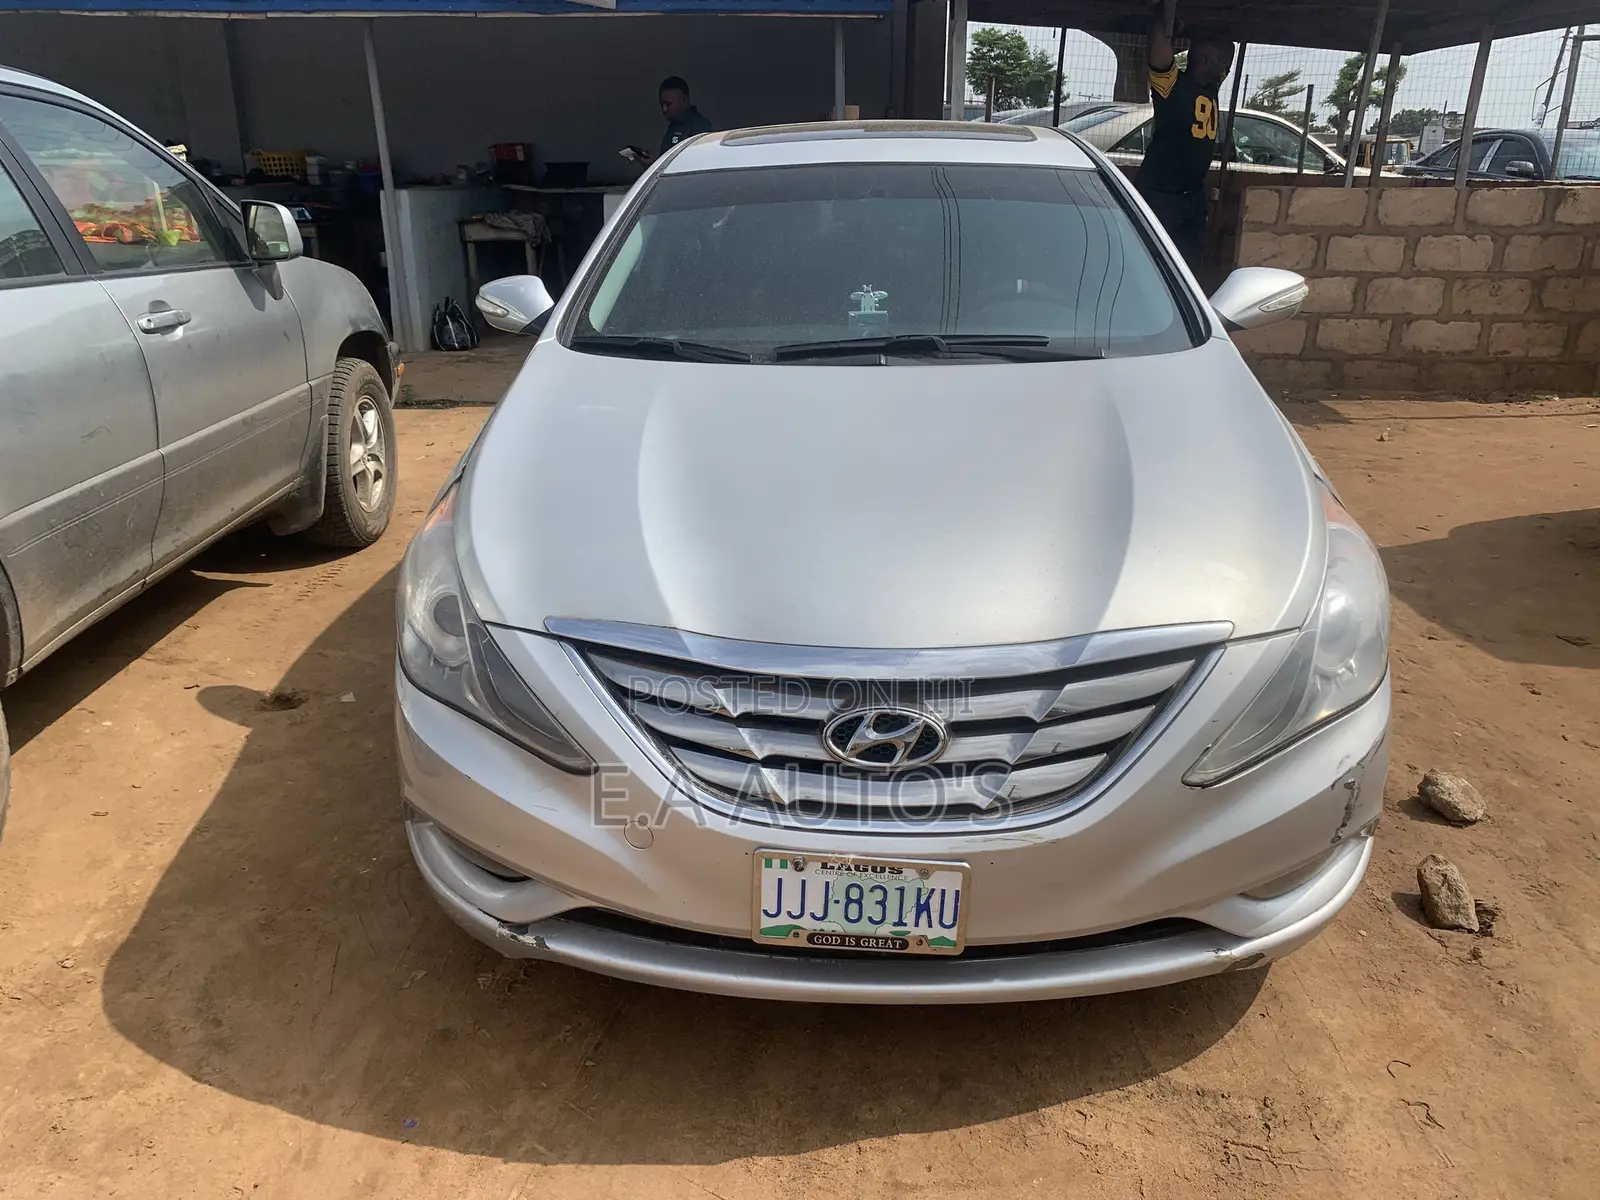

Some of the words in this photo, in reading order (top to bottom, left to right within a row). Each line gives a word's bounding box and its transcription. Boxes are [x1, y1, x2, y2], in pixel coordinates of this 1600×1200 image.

[814, 868, 843, 877] CENTRE
[859, 872, 908, 881] EXCELLENCE
[820, 861, 904, 875] LAGOS
[762, 877, 960, 929] JJJ-831KU
[813, 934, 841, 945] GOD
[844, 936, 856, 946] IS
[860, 938, 902, 949] GREAT
